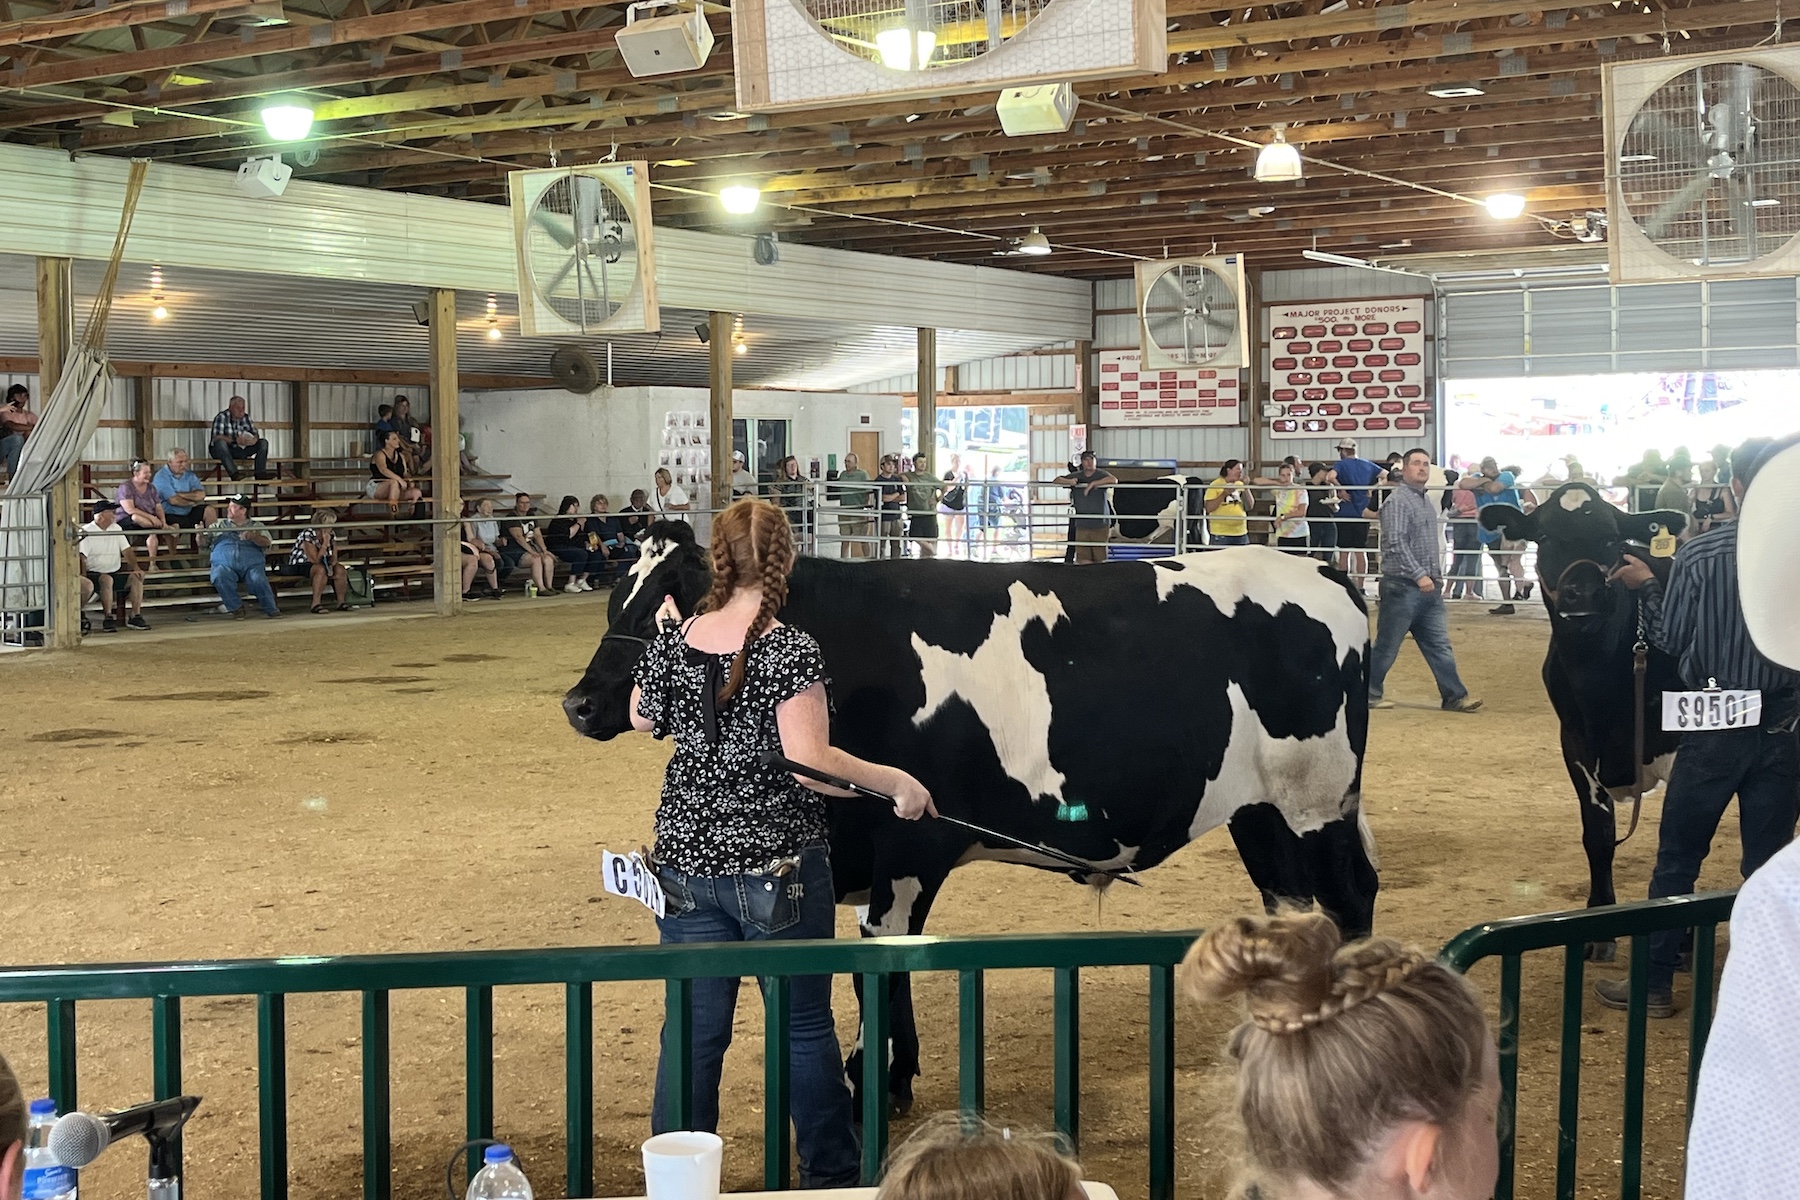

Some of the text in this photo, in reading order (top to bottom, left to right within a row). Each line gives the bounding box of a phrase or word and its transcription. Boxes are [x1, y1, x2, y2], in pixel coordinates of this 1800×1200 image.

[1290, 305, 1400, 318] MAJOR PROJECT DONORS
